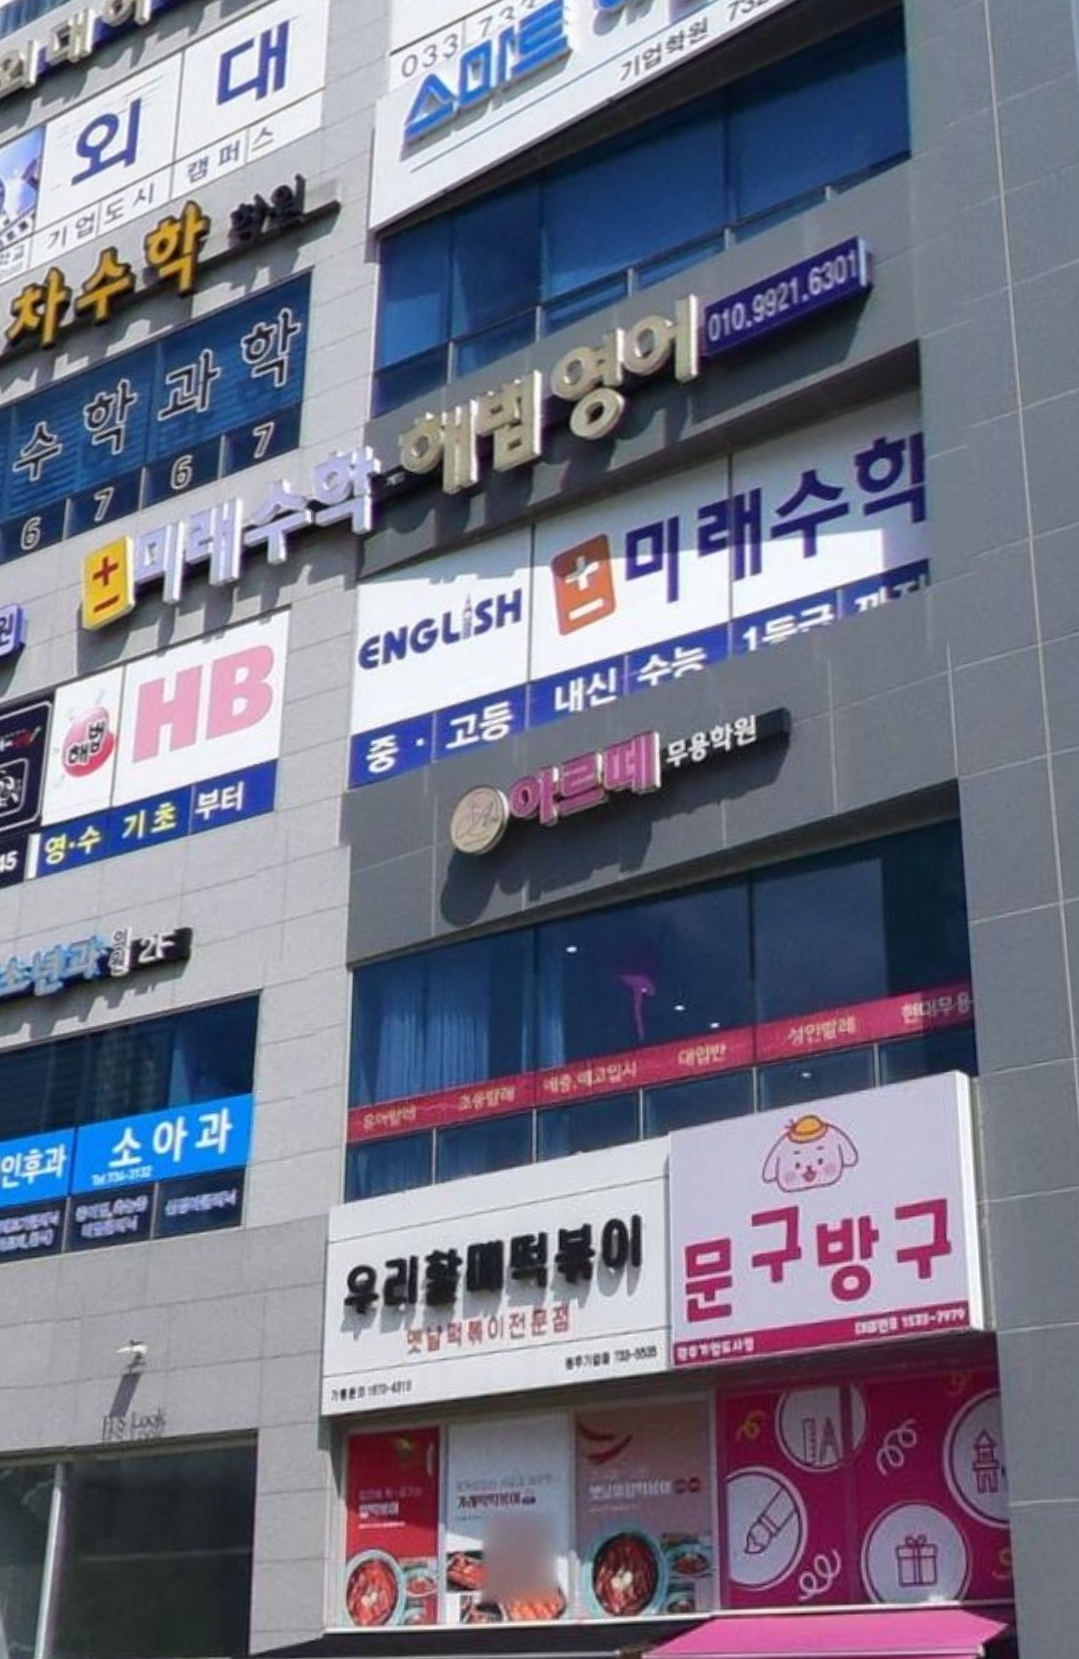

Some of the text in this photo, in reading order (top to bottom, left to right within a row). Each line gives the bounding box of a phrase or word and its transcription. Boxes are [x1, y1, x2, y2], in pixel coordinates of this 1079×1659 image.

[402, 33, 459, 78] 033
[187, 126, 275, 182] 캠퍼스
[707, 249, 858, 343] 010.9921.6301
[132, 445, 381, 602] 미래수학
[357, 587, 522, 671] ENGLISH
[131, 644, 275, 764] HB
[554, 667, 618, 713] 내신
[508, 714, 758, 826] 아르떼 무용학원
[121, 802, 177, 839] 기초
[195, 780, 245, 820] 부터
[137, 930, 176, 964] 2F
[0, 1143, 68, 1190] 인후과
[108, 1106, 233, 1168] 소아과
[685, 1198, 953, 1323] 문구방구
